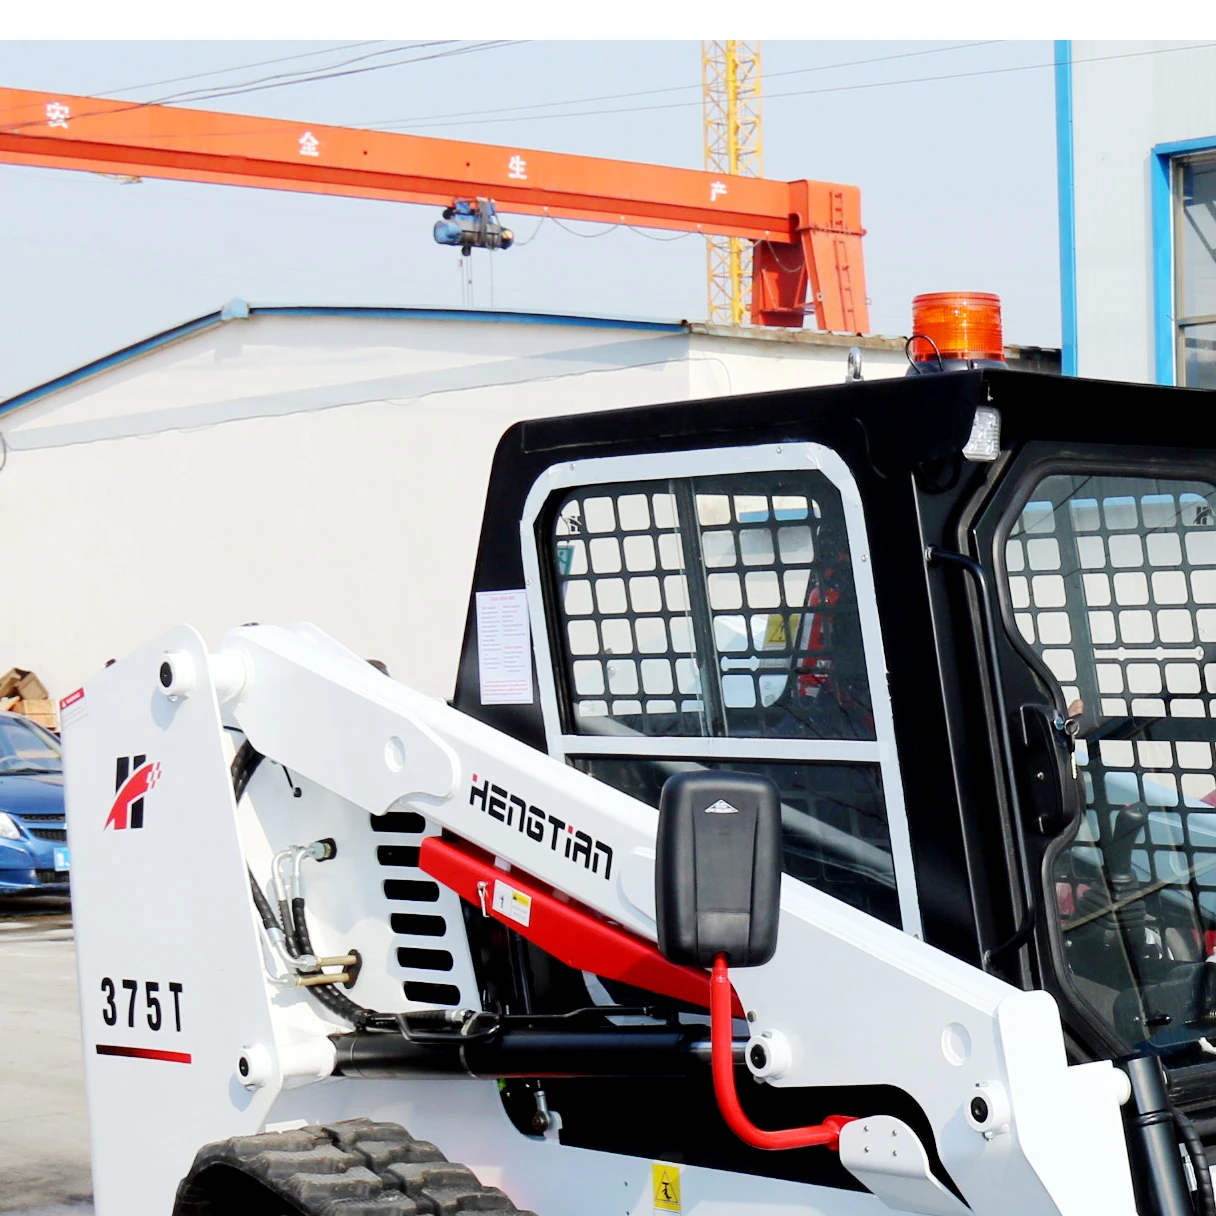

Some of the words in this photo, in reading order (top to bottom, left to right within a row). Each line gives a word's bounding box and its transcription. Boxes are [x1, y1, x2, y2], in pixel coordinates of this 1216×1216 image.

[46, 102, 70, 128] 安
[299, 131, 319, 157] 全
[508, 155, 528, 179] 生
[711, 181, 728, 201] 产
[101, 977, 183, 1032] 375T
